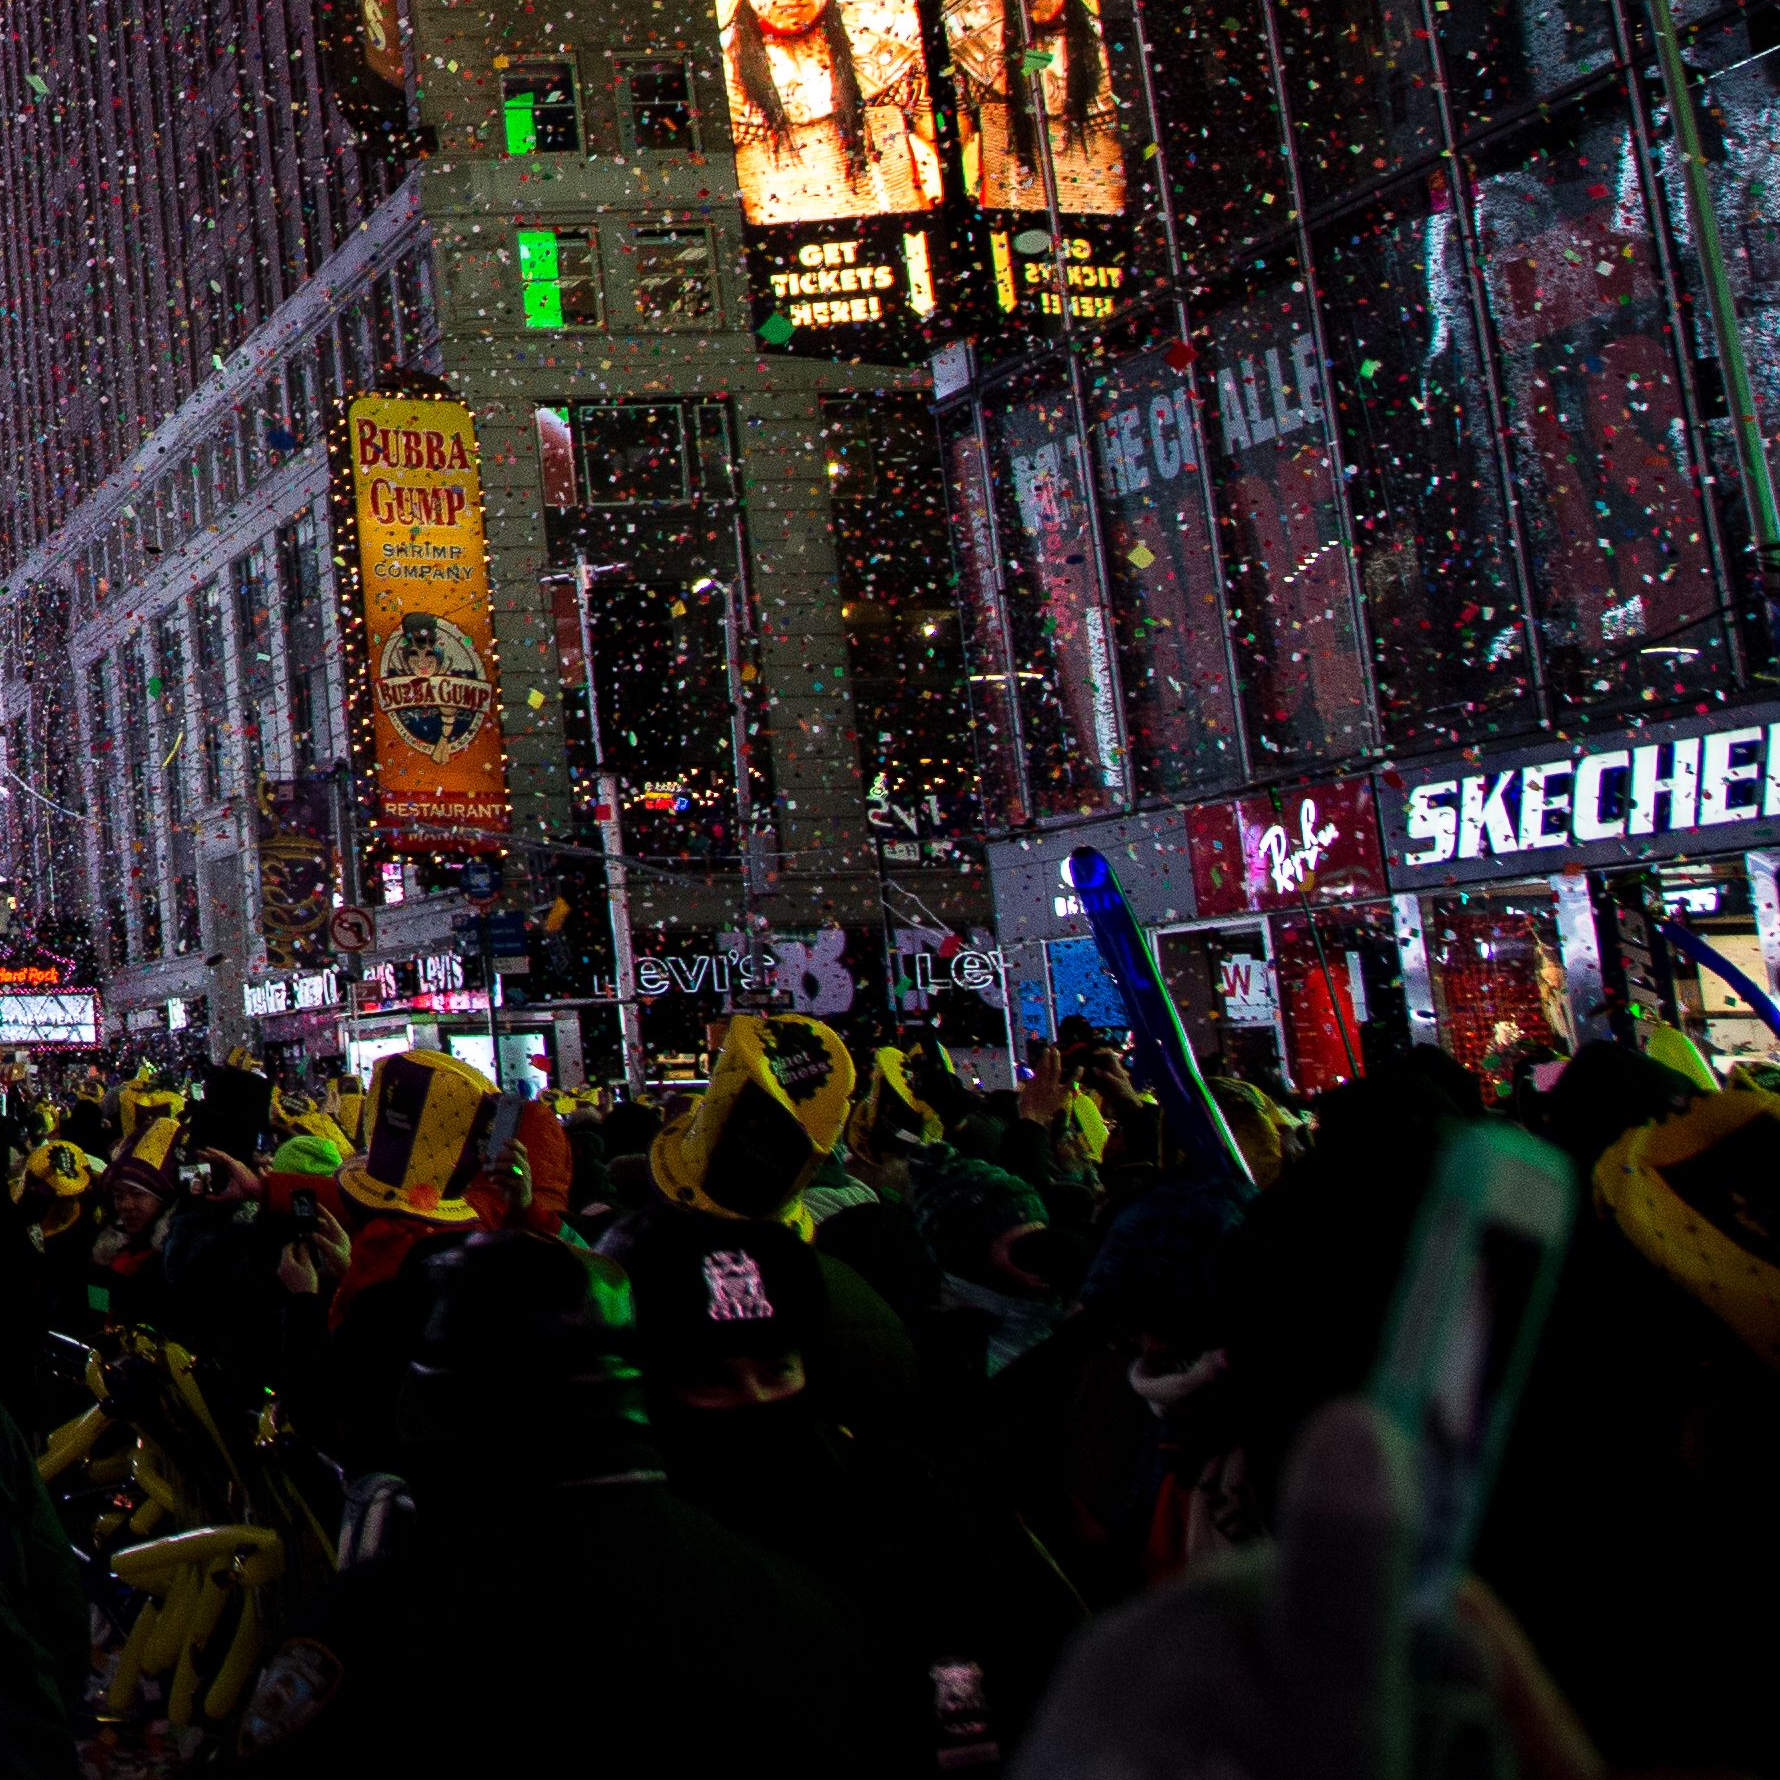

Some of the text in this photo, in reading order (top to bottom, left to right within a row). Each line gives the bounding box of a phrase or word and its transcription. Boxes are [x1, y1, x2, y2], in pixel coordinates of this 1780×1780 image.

[799, 241, 858, 268] GET
[770, 266, 895, 299] TICKETS
[356, 416, 472, 472] BUBBA
[369, 476, 467, 528] GUMP
[382, 541, 465, 560] SHRIMP
[374, 562, 475, 582] COMPANY
[440, 678, 490, 711] GUMP
[1405, 722, 1780, 867] SKECHE
[384, 802, 503, 819] RESTAURANT
[28, 966, 60, 985] Rock
